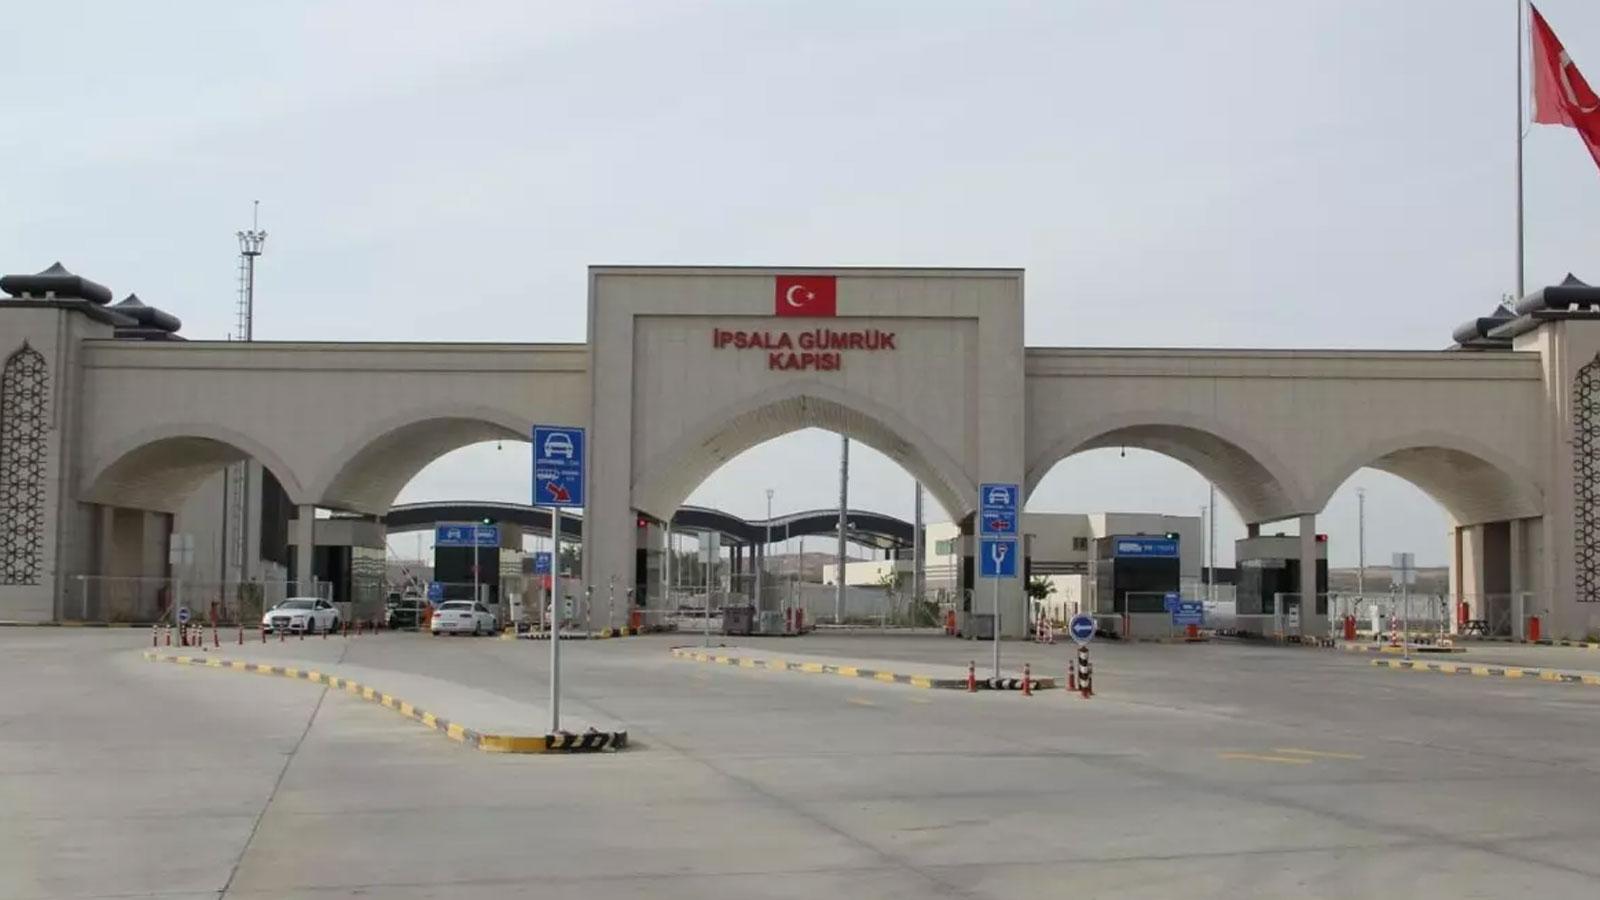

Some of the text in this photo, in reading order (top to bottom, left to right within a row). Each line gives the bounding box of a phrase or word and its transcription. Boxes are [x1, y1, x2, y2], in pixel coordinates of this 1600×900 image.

[713, 328, 896, 350] İPSALA GÜMRÜK
[768, 352, 841, 371] KAPISI
